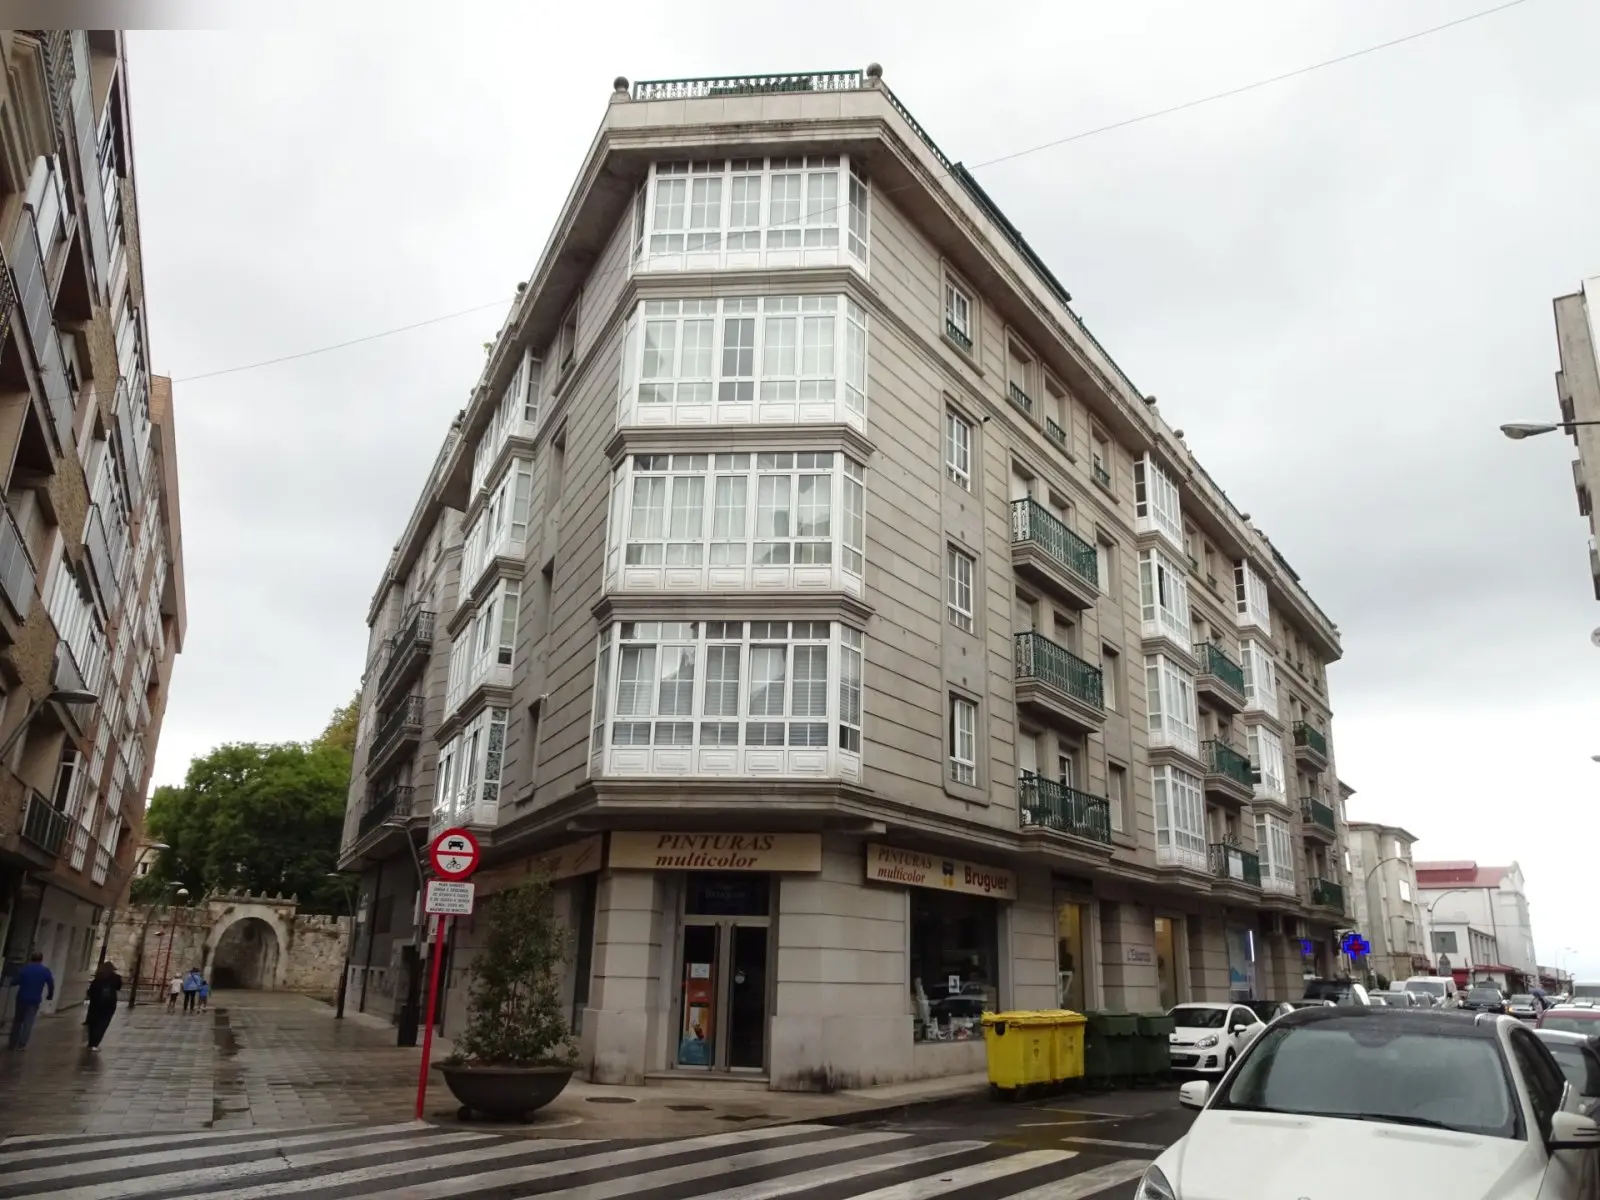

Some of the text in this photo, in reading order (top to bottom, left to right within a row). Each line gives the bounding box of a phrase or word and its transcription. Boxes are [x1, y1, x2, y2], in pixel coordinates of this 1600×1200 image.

[656, 834, 775, 851] PINTURAS
[655, 852, 758, 868] multicolor
[877, 847, 932, 869] PINTURAS
[877, 865, 926, 884] multicolor
[964, 865, 1009, 892] Bruguer
